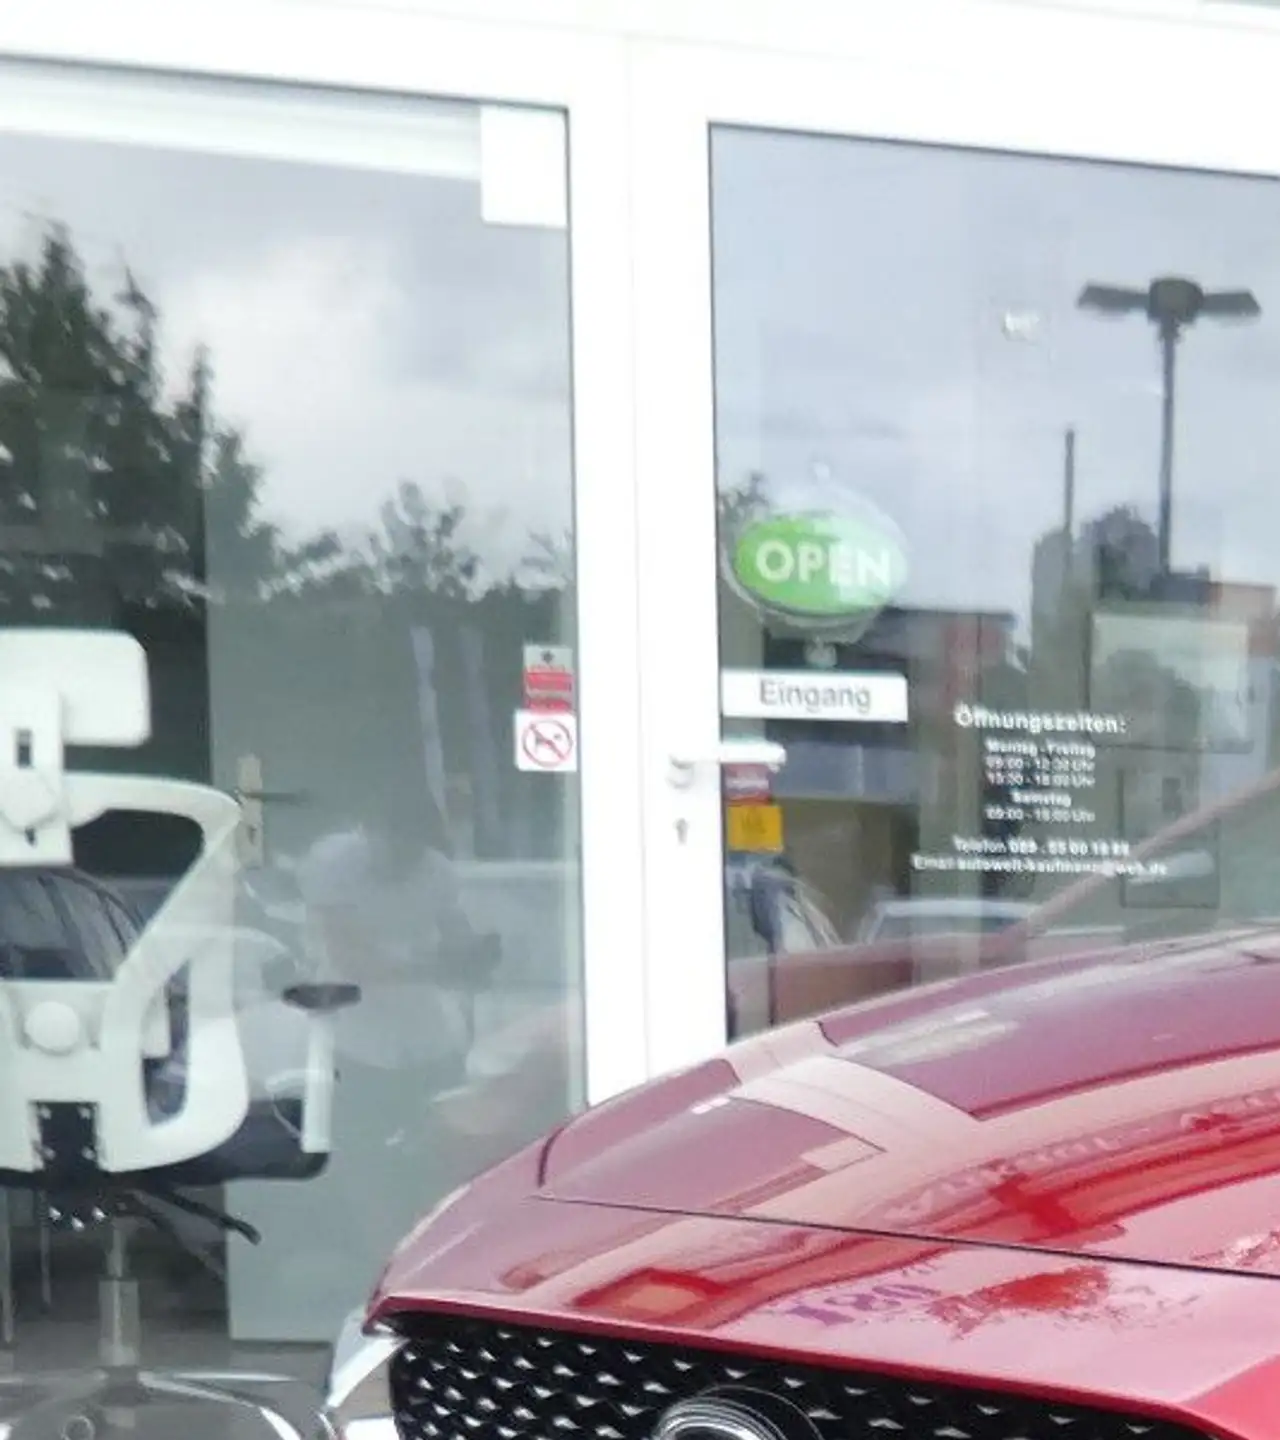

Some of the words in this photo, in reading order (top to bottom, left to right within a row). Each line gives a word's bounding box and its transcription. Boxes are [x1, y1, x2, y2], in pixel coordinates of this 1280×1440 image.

[756, 540, 889, 587] OPEN
[760, 679, 871, 713] Eingang
[954, 702, 1127, 734] Öffnungszeiten:
